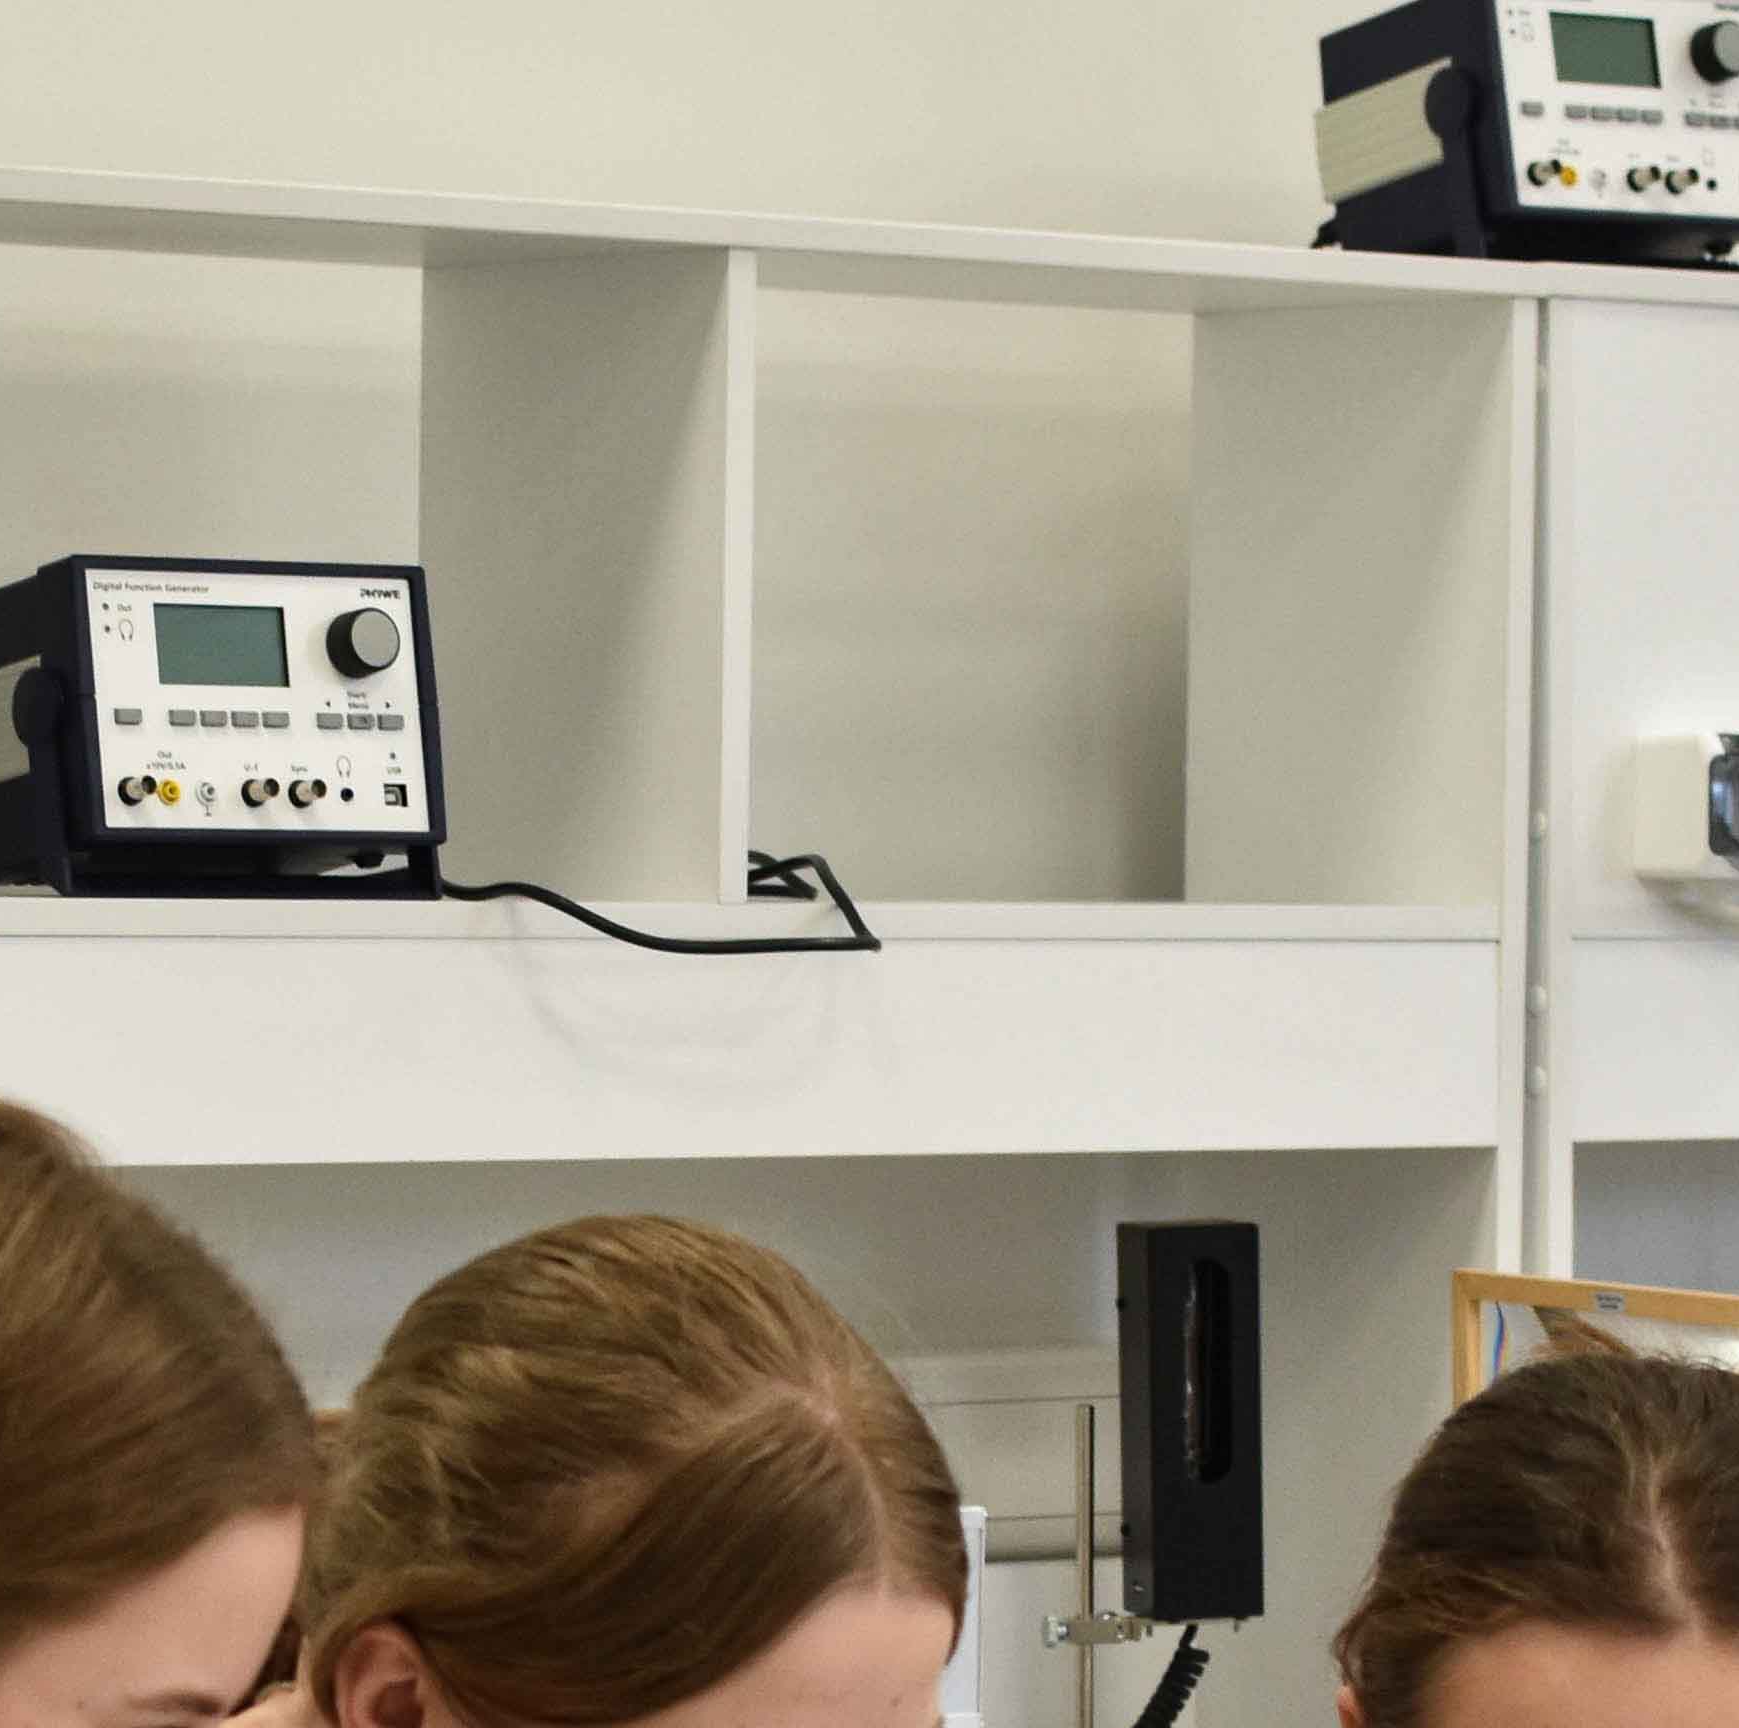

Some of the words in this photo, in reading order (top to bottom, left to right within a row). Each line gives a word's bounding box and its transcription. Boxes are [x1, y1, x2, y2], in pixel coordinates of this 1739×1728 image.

[93, 581, 122, 592] Digital
[125, 582, 162, 592] Function
[165, 583, 209, 593] Generator
